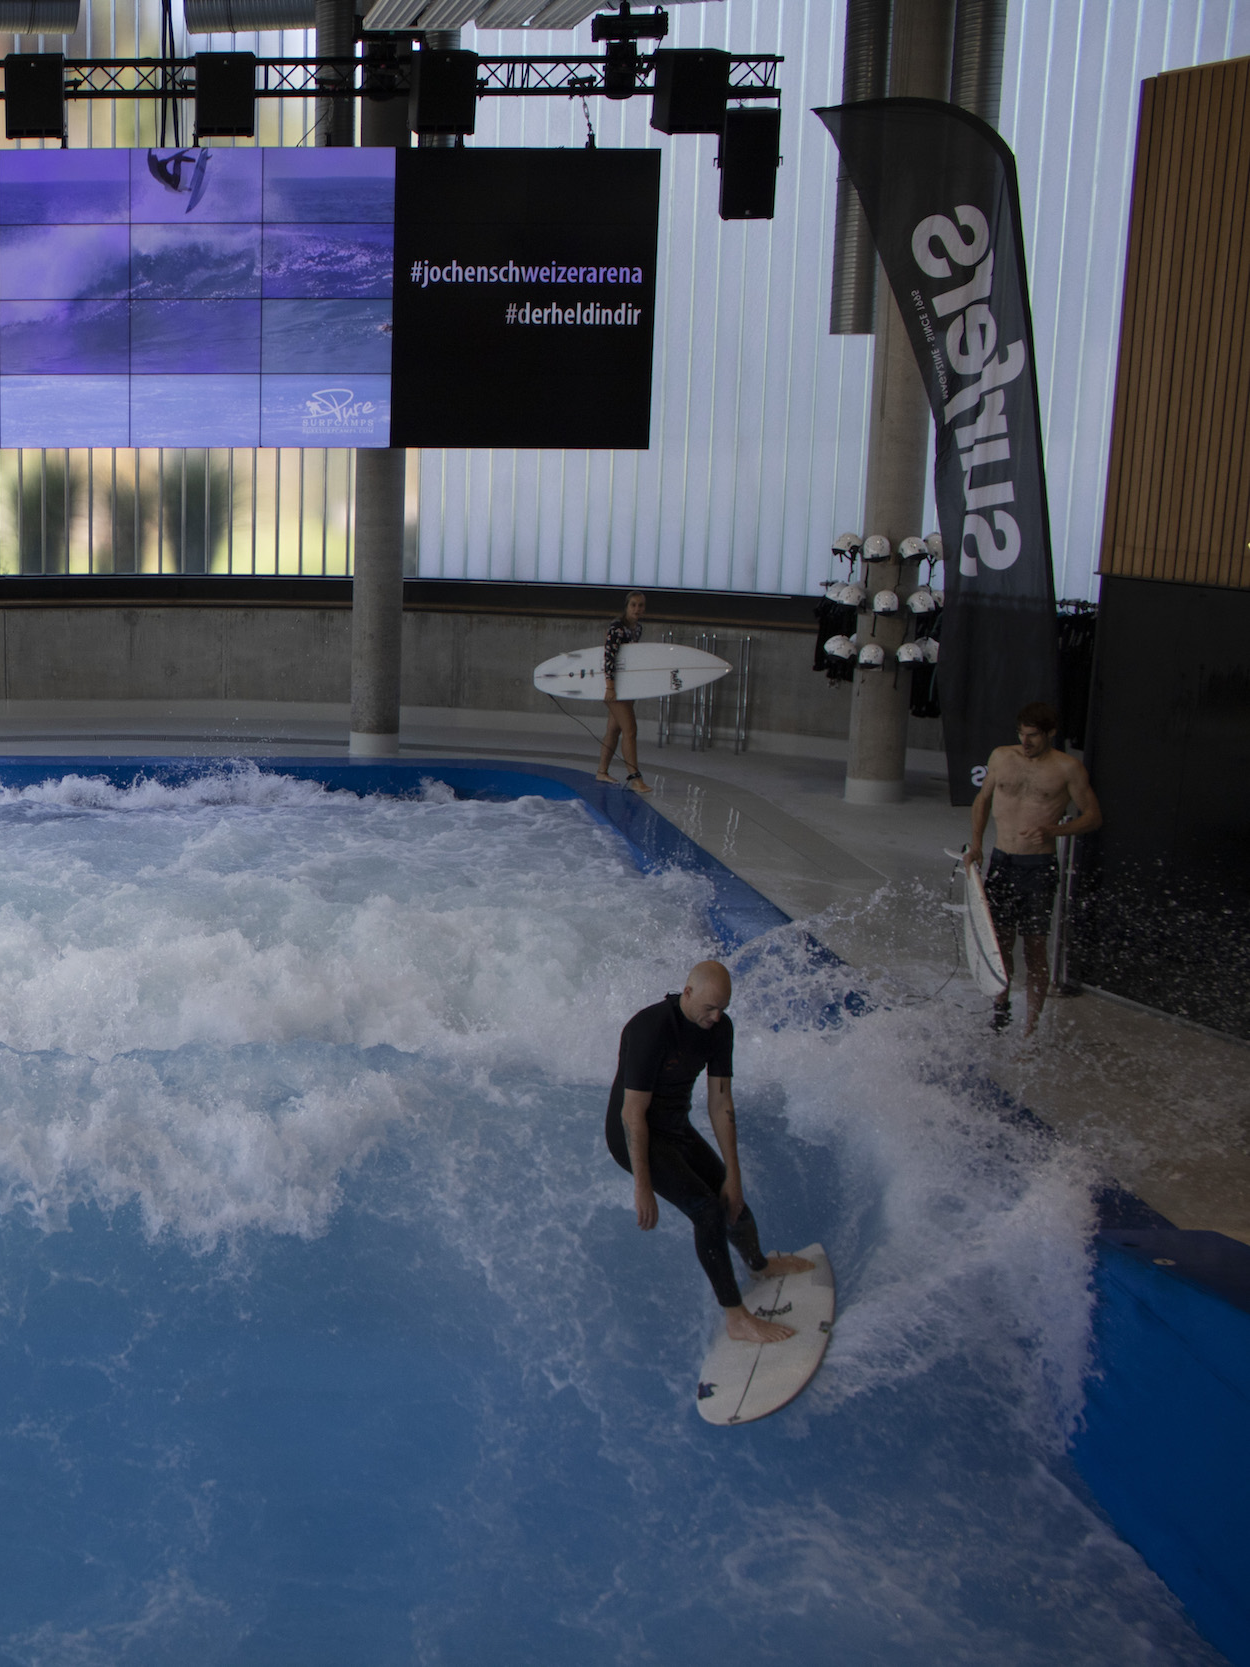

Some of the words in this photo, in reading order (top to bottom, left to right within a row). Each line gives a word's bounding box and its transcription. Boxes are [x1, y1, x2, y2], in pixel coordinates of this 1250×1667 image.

[410, 259, 643, 288] #jochenschweizerarena
[505, 301, 642, 326] #derheldindir
[311, 388, 376, 423] Pure
[302, 418, 374, 428] SURFCAMPS
